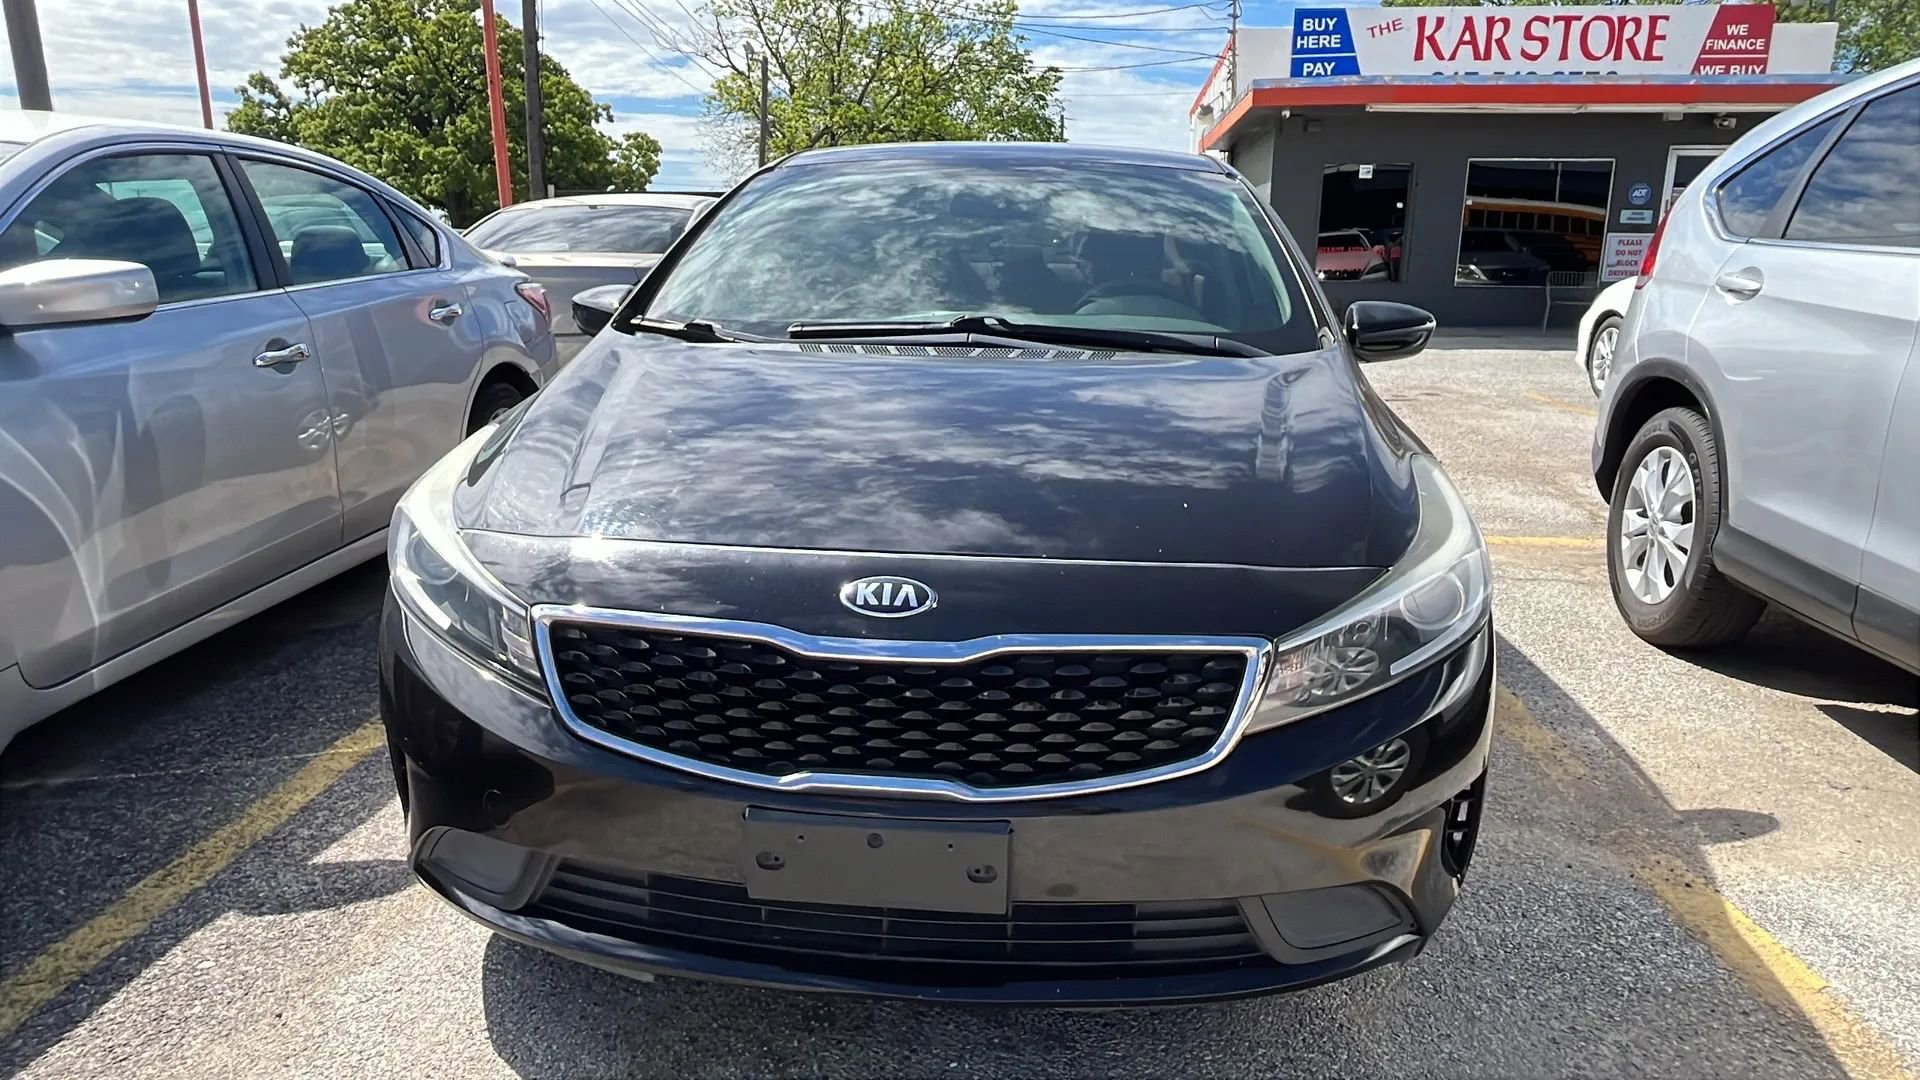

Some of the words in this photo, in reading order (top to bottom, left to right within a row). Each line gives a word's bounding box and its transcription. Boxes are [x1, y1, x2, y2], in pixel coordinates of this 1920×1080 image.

[1302, 17, 1337, 32] BUY
[1726, 24, 1749, 36] WE
[1296, 34, 1341, 49] HERE
[1367, 18, 1404, 38] THE
[1414, 15, 1511, 62] KAR
[1520, 15, 1670, 62] STORE
[1705, 38, 1766, 50] FINANCE
[1302, 62, 1336, 76] PAY
[1617, 259, 1638, 267] BLOCK
[856, 582, 919, 608] KIA
